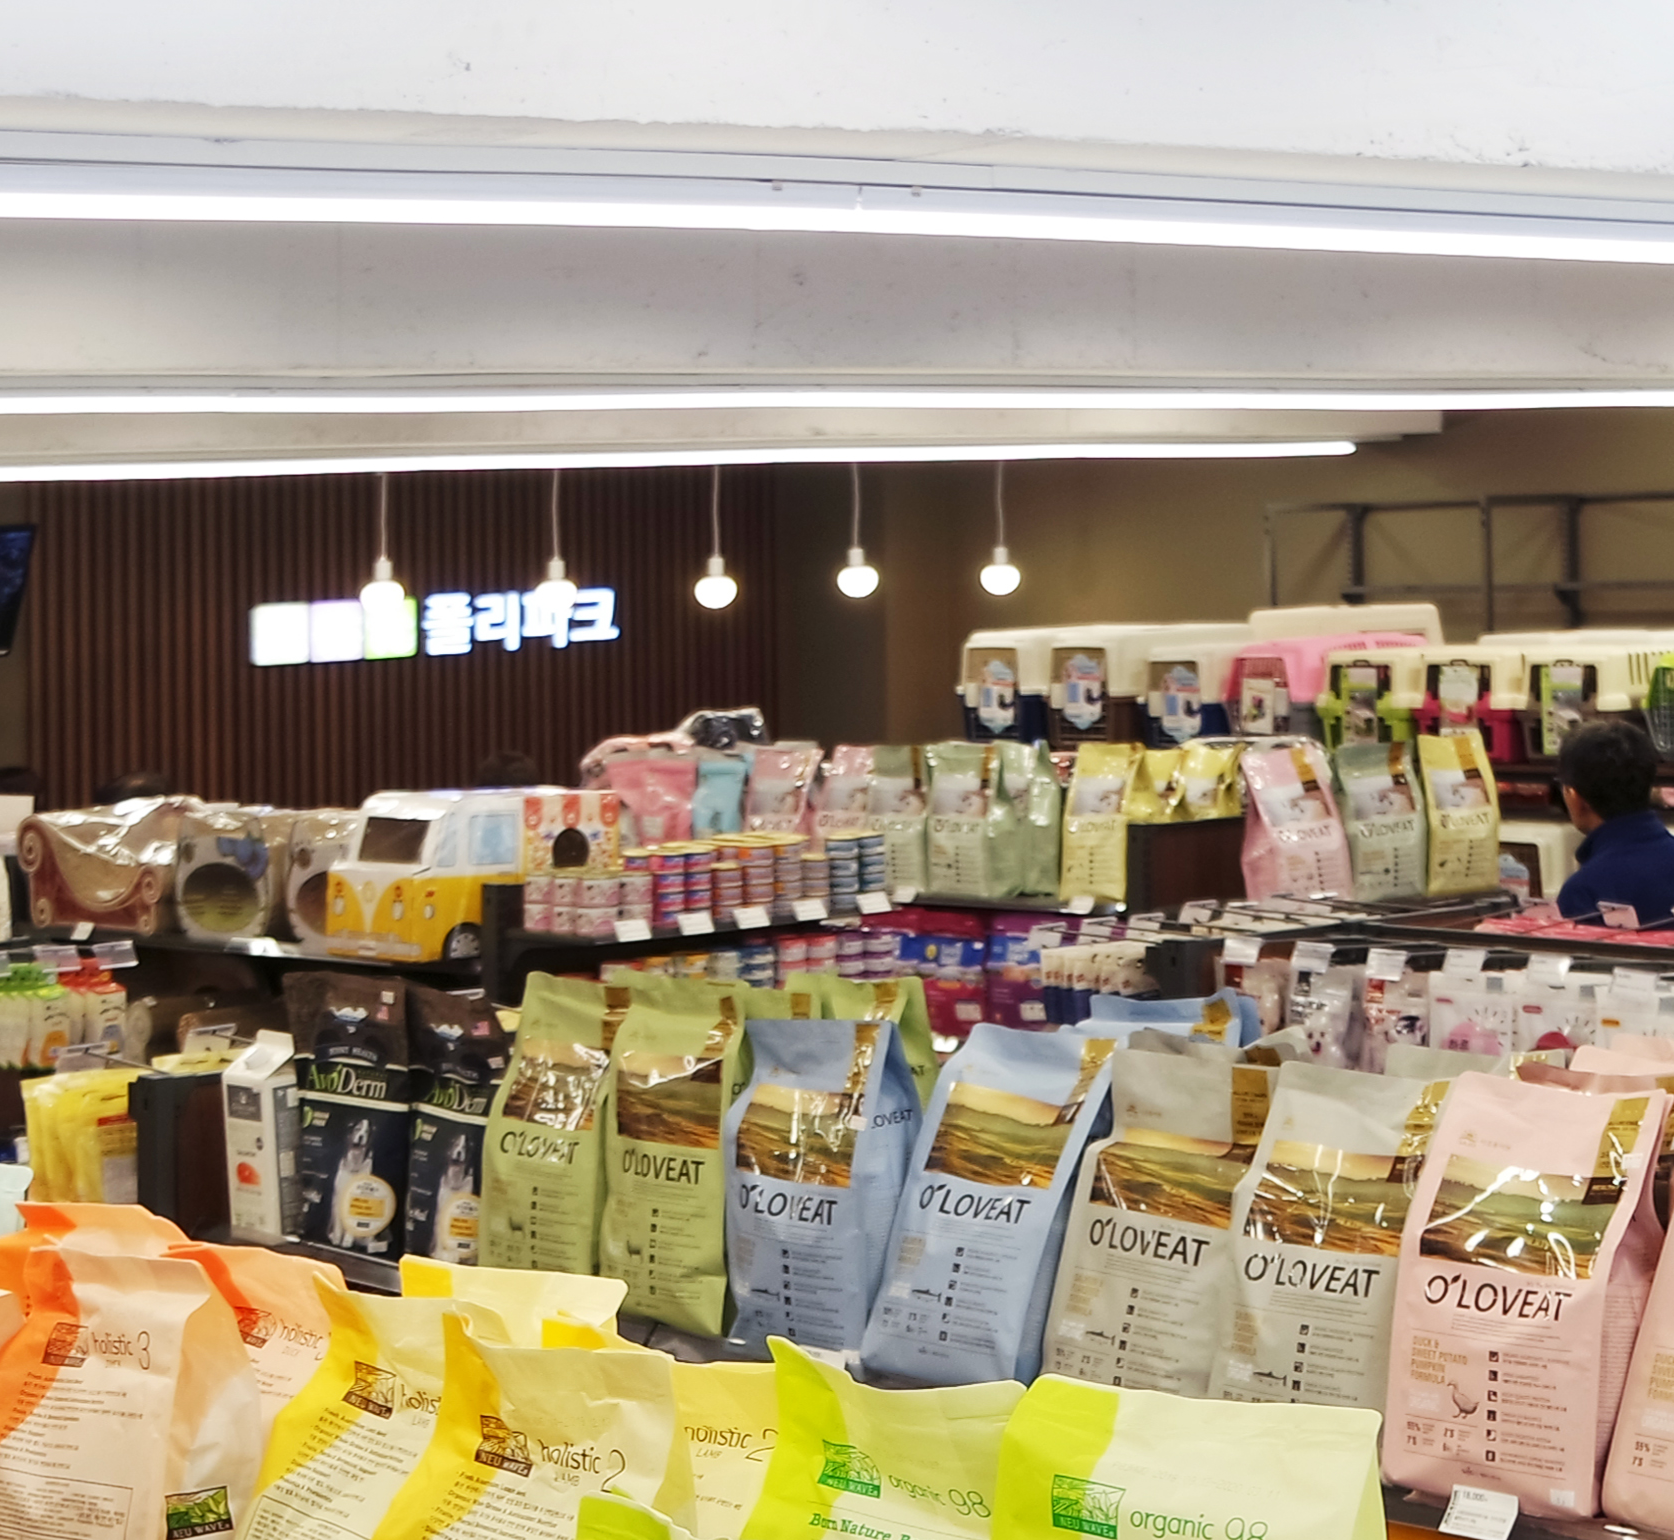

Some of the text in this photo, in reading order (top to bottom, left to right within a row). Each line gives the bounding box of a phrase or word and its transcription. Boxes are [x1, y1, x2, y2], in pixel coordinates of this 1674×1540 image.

[422, 588, 620, 656] 폴리파크
[623, 1149, 705, 1185] O'LOVEAT
[918, 1182, 1031, 1224] O'LOVEAT
[1089, 1217, 1210, 1267] O'LOVEAT
[1244, 1252, 1380, 1298] O'LOVEAT
[1424, 1272, 1573, 1323] O'LOVEAT
[91, 1331, 151, 1371] holistic 3
[481, 1453, 501, 1467] NEU
[536, 1438, 626, 1494] holistic 2
[847, 1482, 879, 1497] WAVE
[889, 1473, 992, 1519] organic 98
[194, 1521, 227, 1536] WAVE
[809, 1512, 839, 1532] Born
[1059, 1515, 1117, 1538] NEU WAVE
